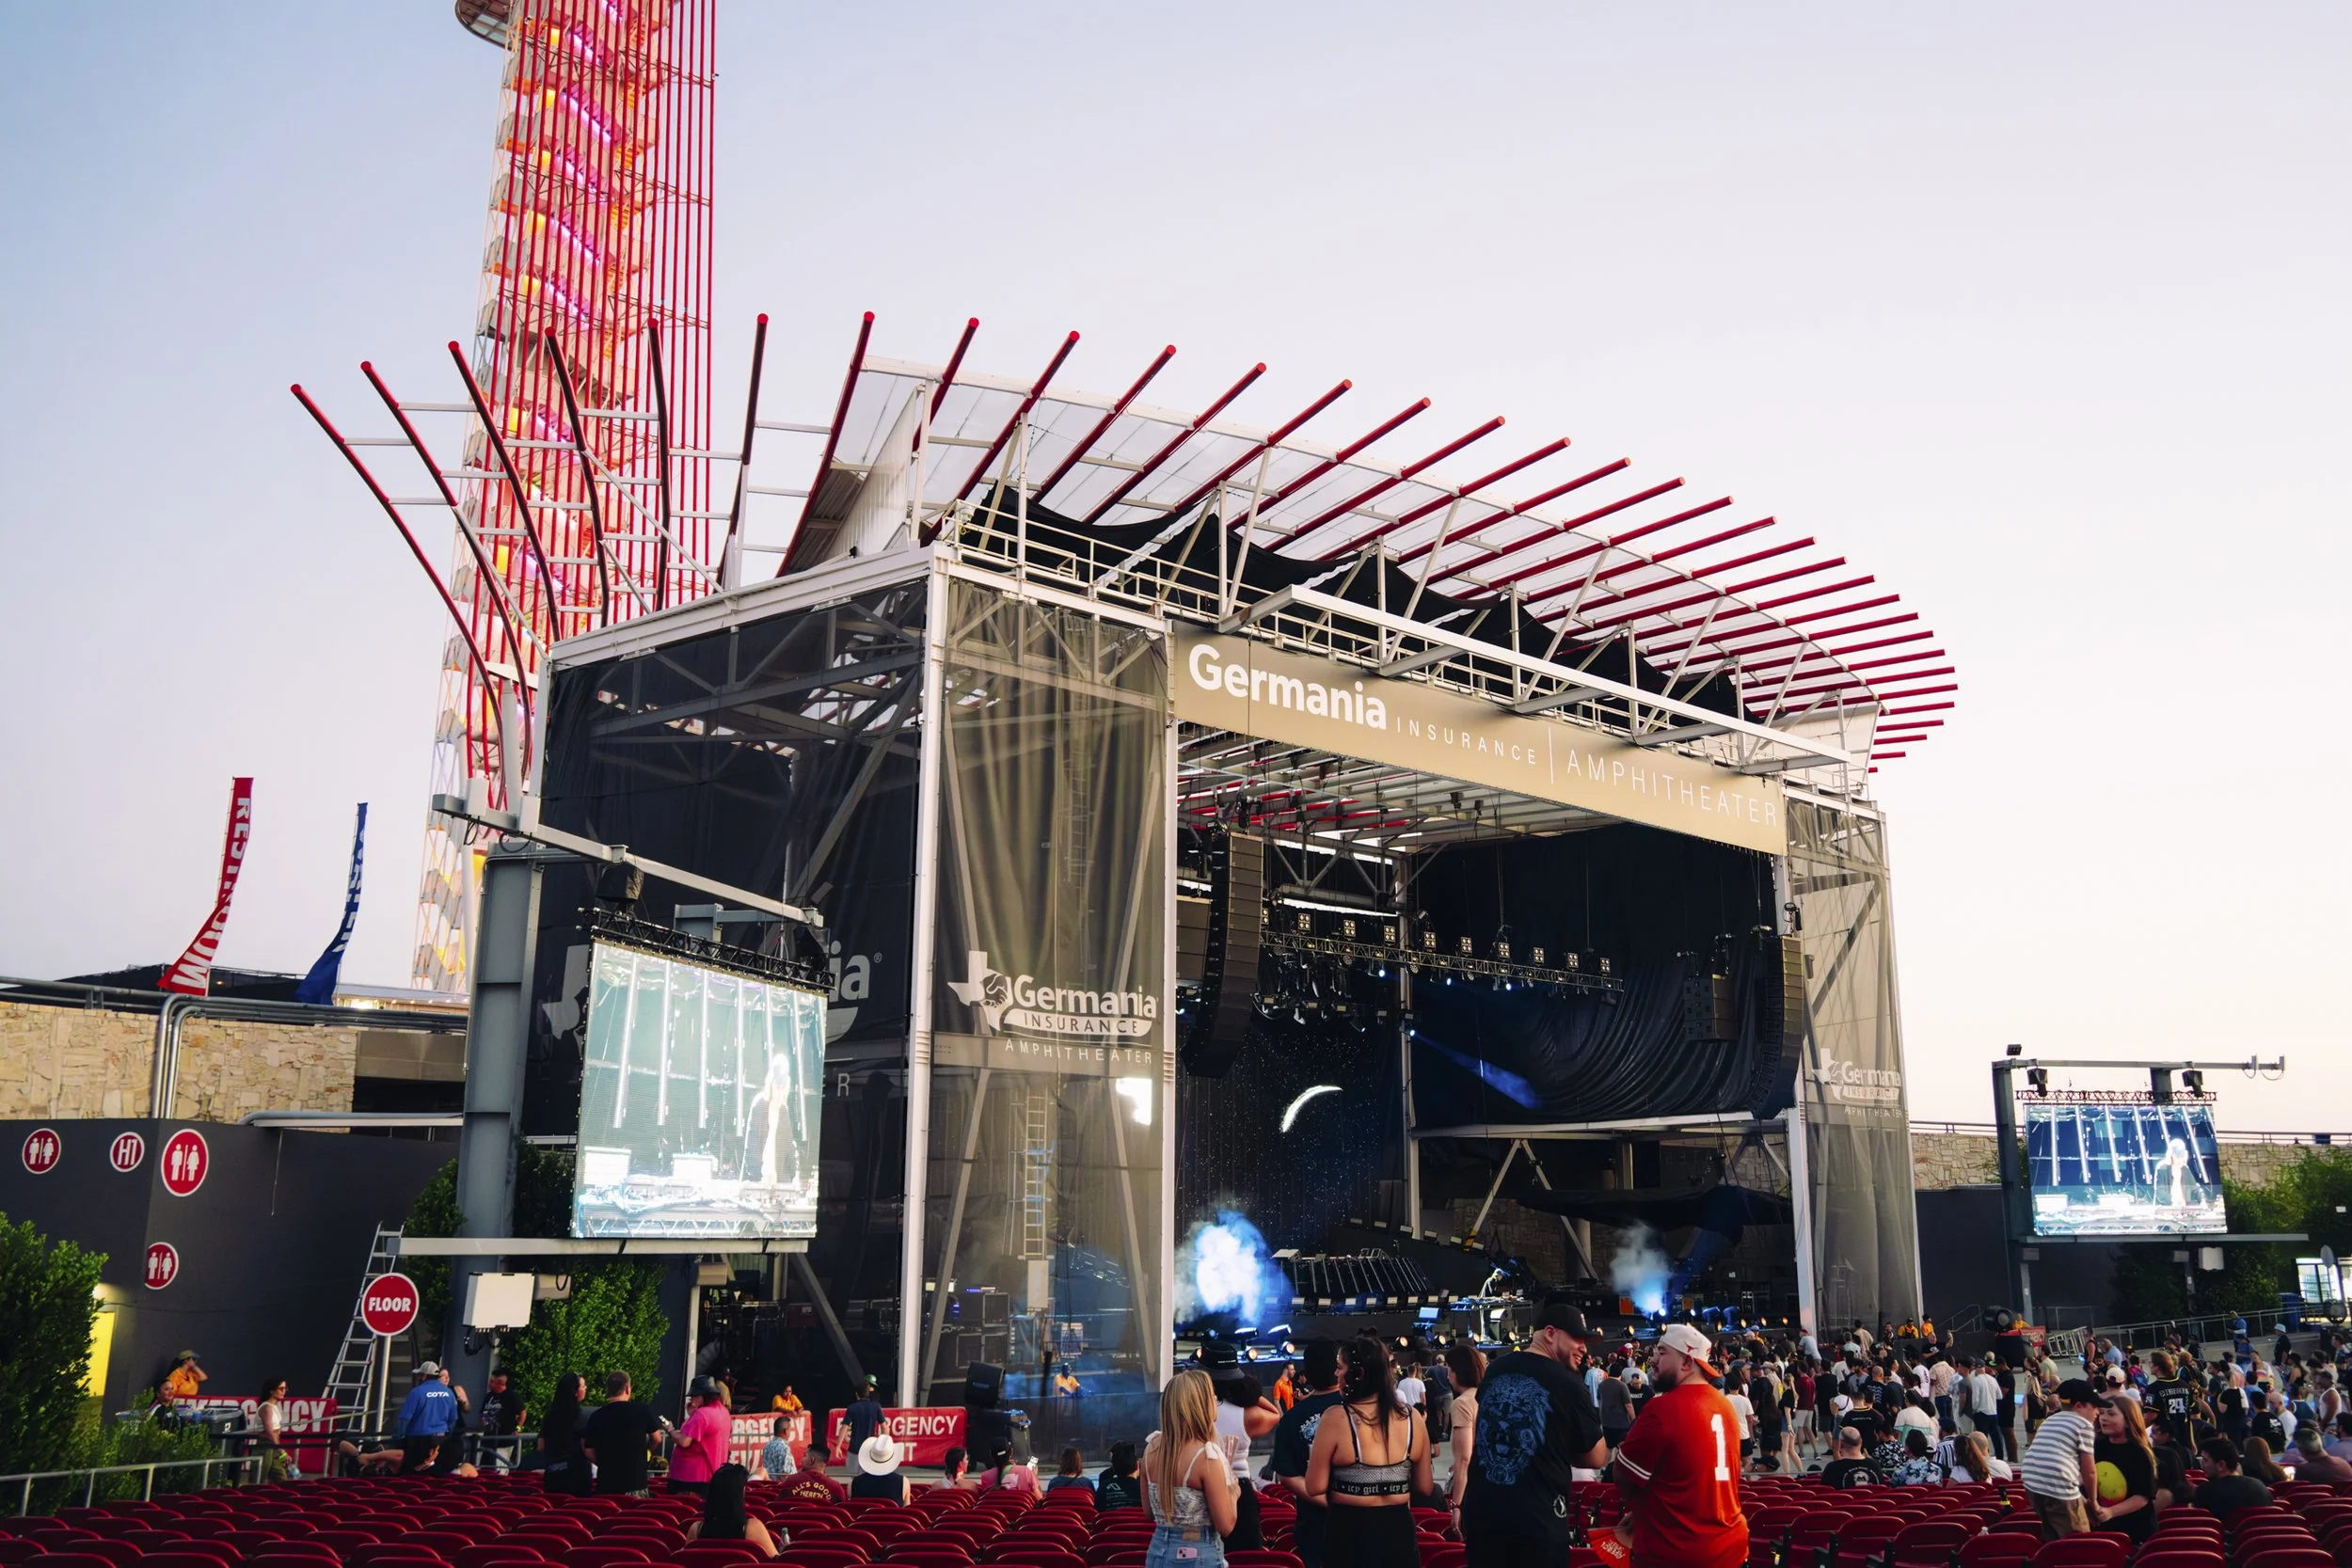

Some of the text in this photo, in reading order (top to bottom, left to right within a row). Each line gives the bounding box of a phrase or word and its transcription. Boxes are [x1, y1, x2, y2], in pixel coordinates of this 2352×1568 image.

[1188, 643, 1777, 827] Germania INSURANCE AMPHITHEATER
[1014, 974, 1157, 1019] Germania
[1024, 1012, 1138, 1034] INSURANCE
[1005, 1038, 1152, 1064] AMPHITHEATER
[117, 1138, 138, 1165] H1
[368, 1297, 412, 1312] FLOOR
[1710, 1414, 1730, 1481] 1
[1362, 1484, 1379, 1495] girl
